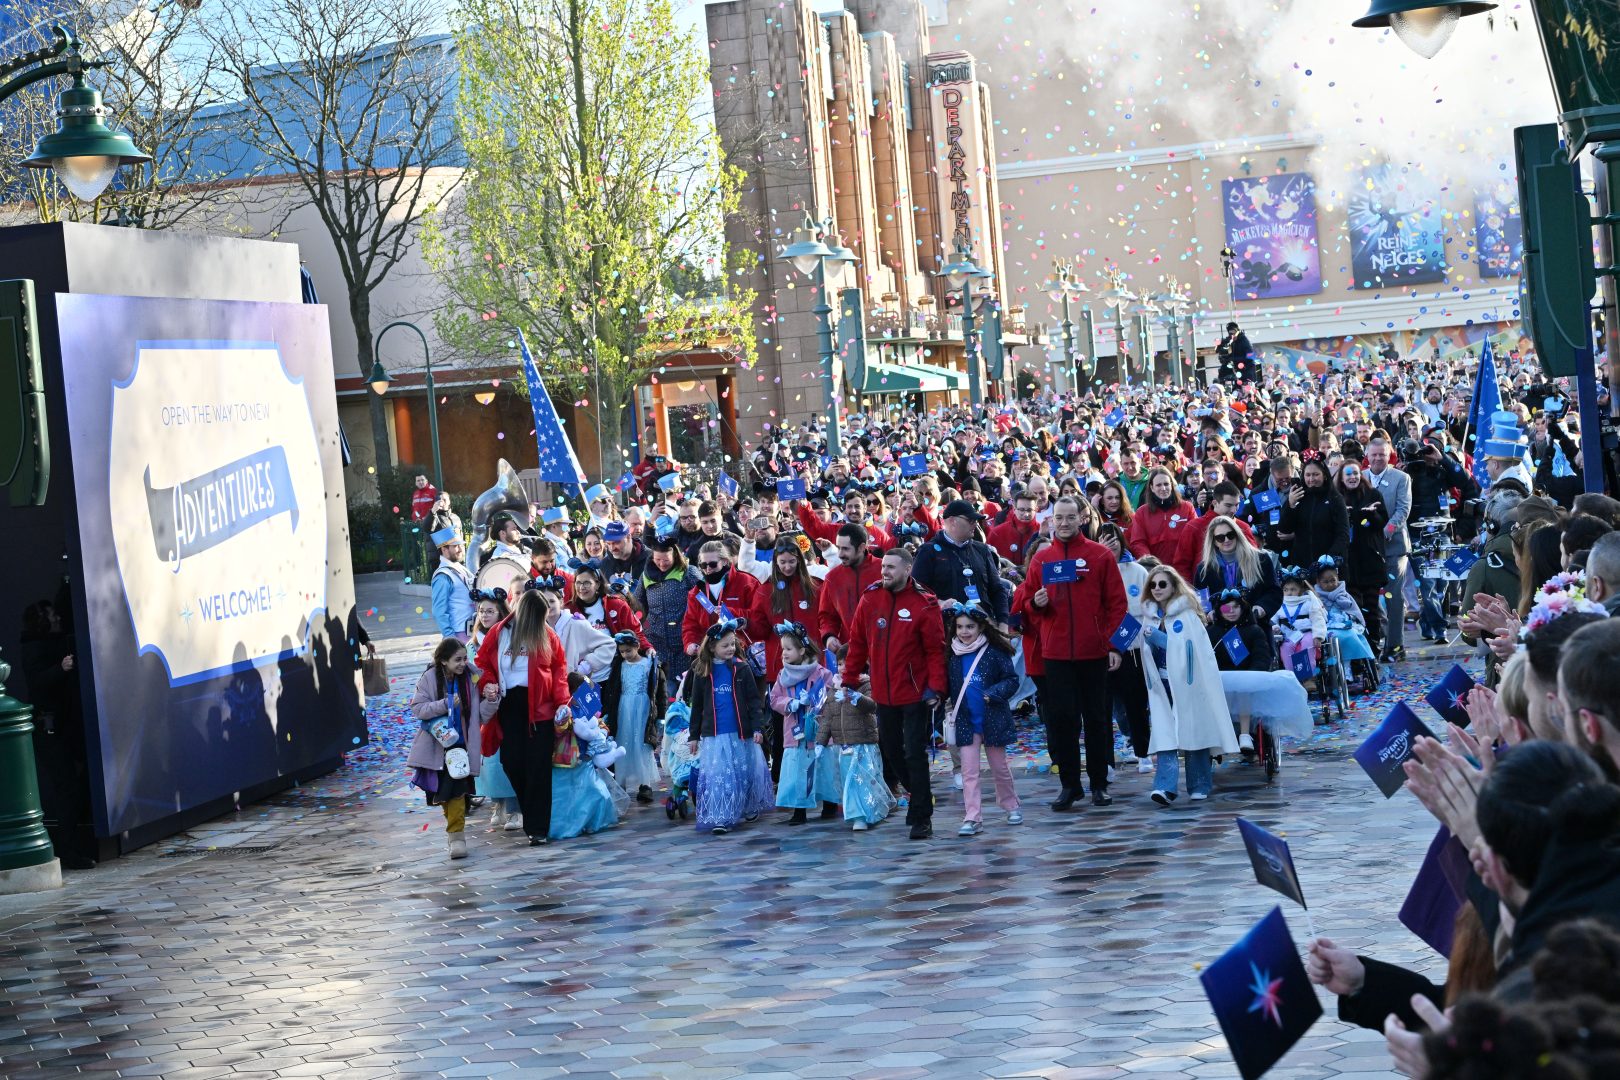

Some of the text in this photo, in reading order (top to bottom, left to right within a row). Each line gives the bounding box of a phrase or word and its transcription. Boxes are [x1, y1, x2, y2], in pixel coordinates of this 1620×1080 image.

[942, 88, 971, 247] DEPARTMEN
[162, 402, 270, 426] OPEN THE WAY TO NEW
[169, 461, 275, 574] ADVENTURES
[199, 585, 272, 621] WELCOME!
